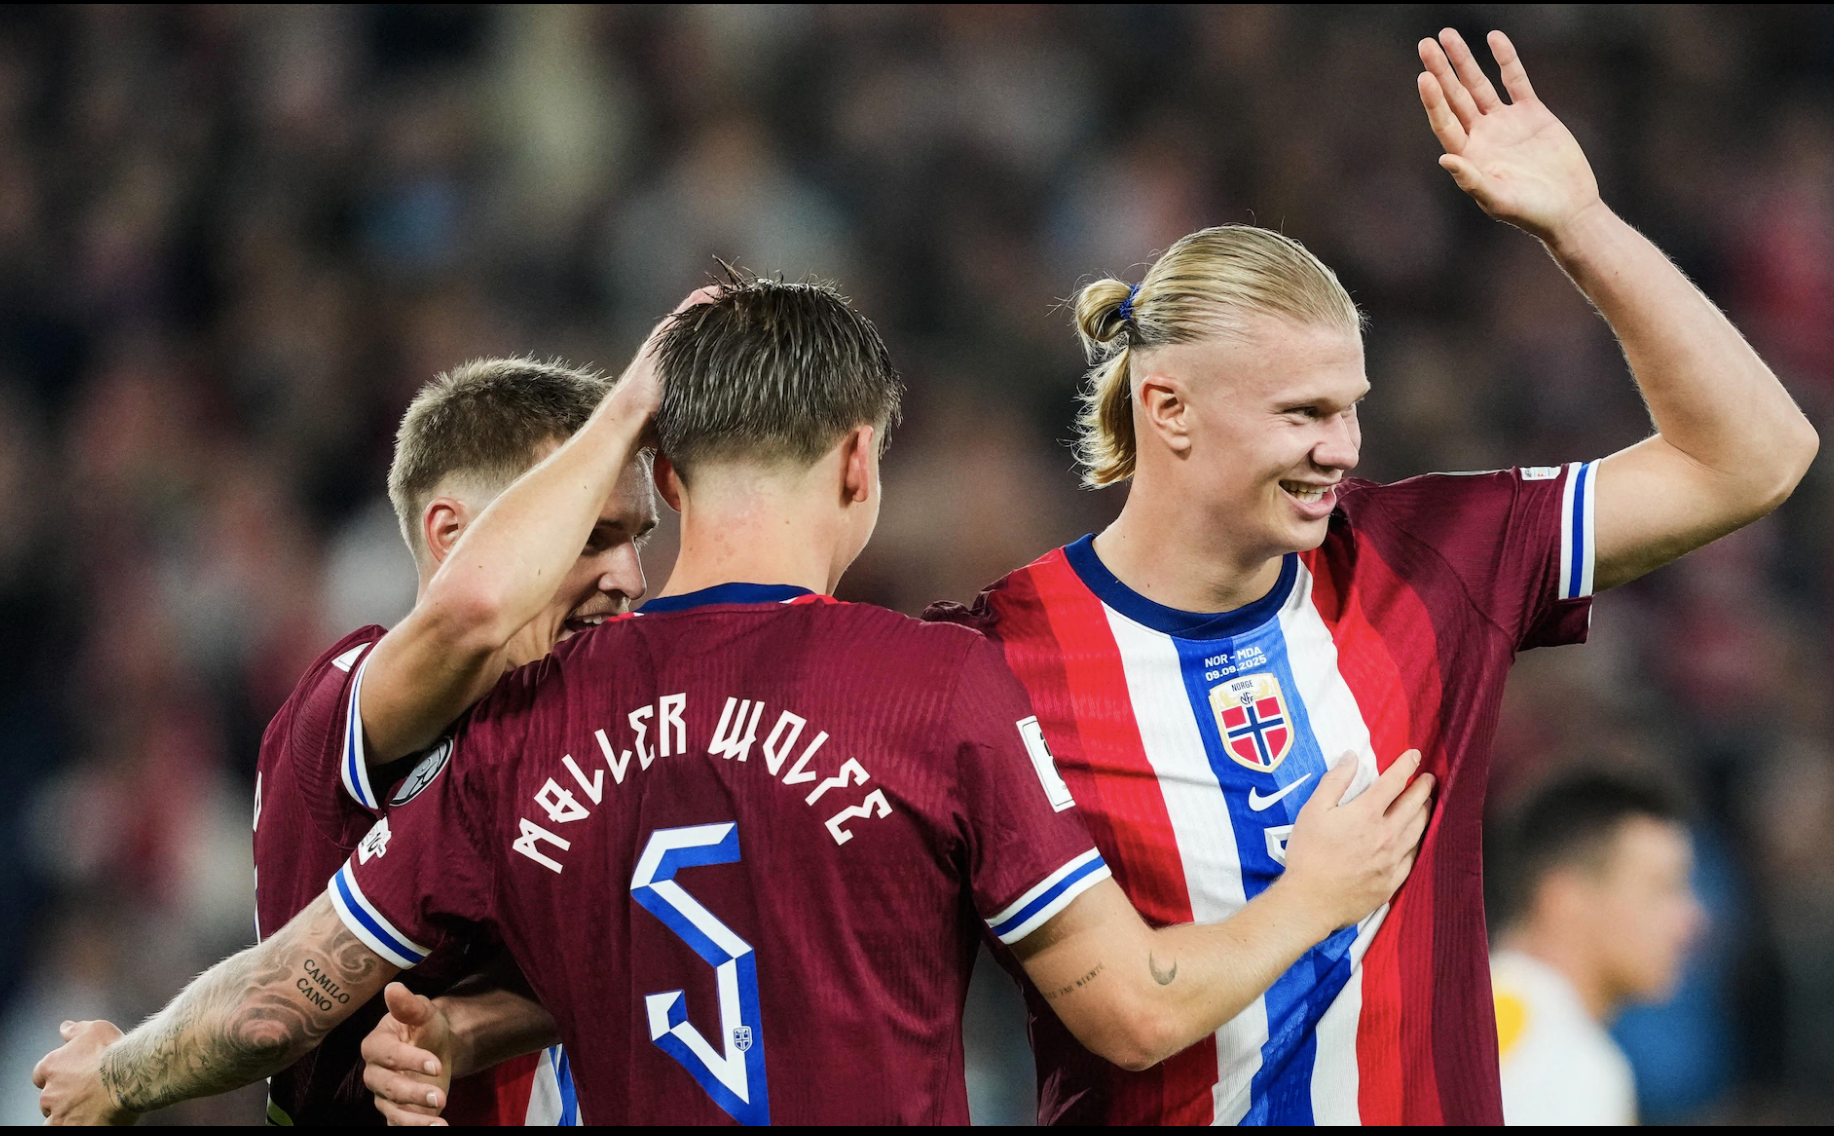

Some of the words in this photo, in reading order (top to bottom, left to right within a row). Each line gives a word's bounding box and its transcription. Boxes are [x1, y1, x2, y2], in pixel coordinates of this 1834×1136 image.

[1205, 654, 1228, 668] NOR
[1237, 646, 1262, 660] MDA
[1205, 654, 1267, 681] 09.09.2025
[1231, 680, 1253, 692] NORGE
[512, 692, 686, 875] MØLLER
[707, 696, 893, 846] WOLFE
[303, 958, 350, 1004] CAMILO
[630, 821, 771, 1126] 5
[296, 977, 332, 1011] CANO
